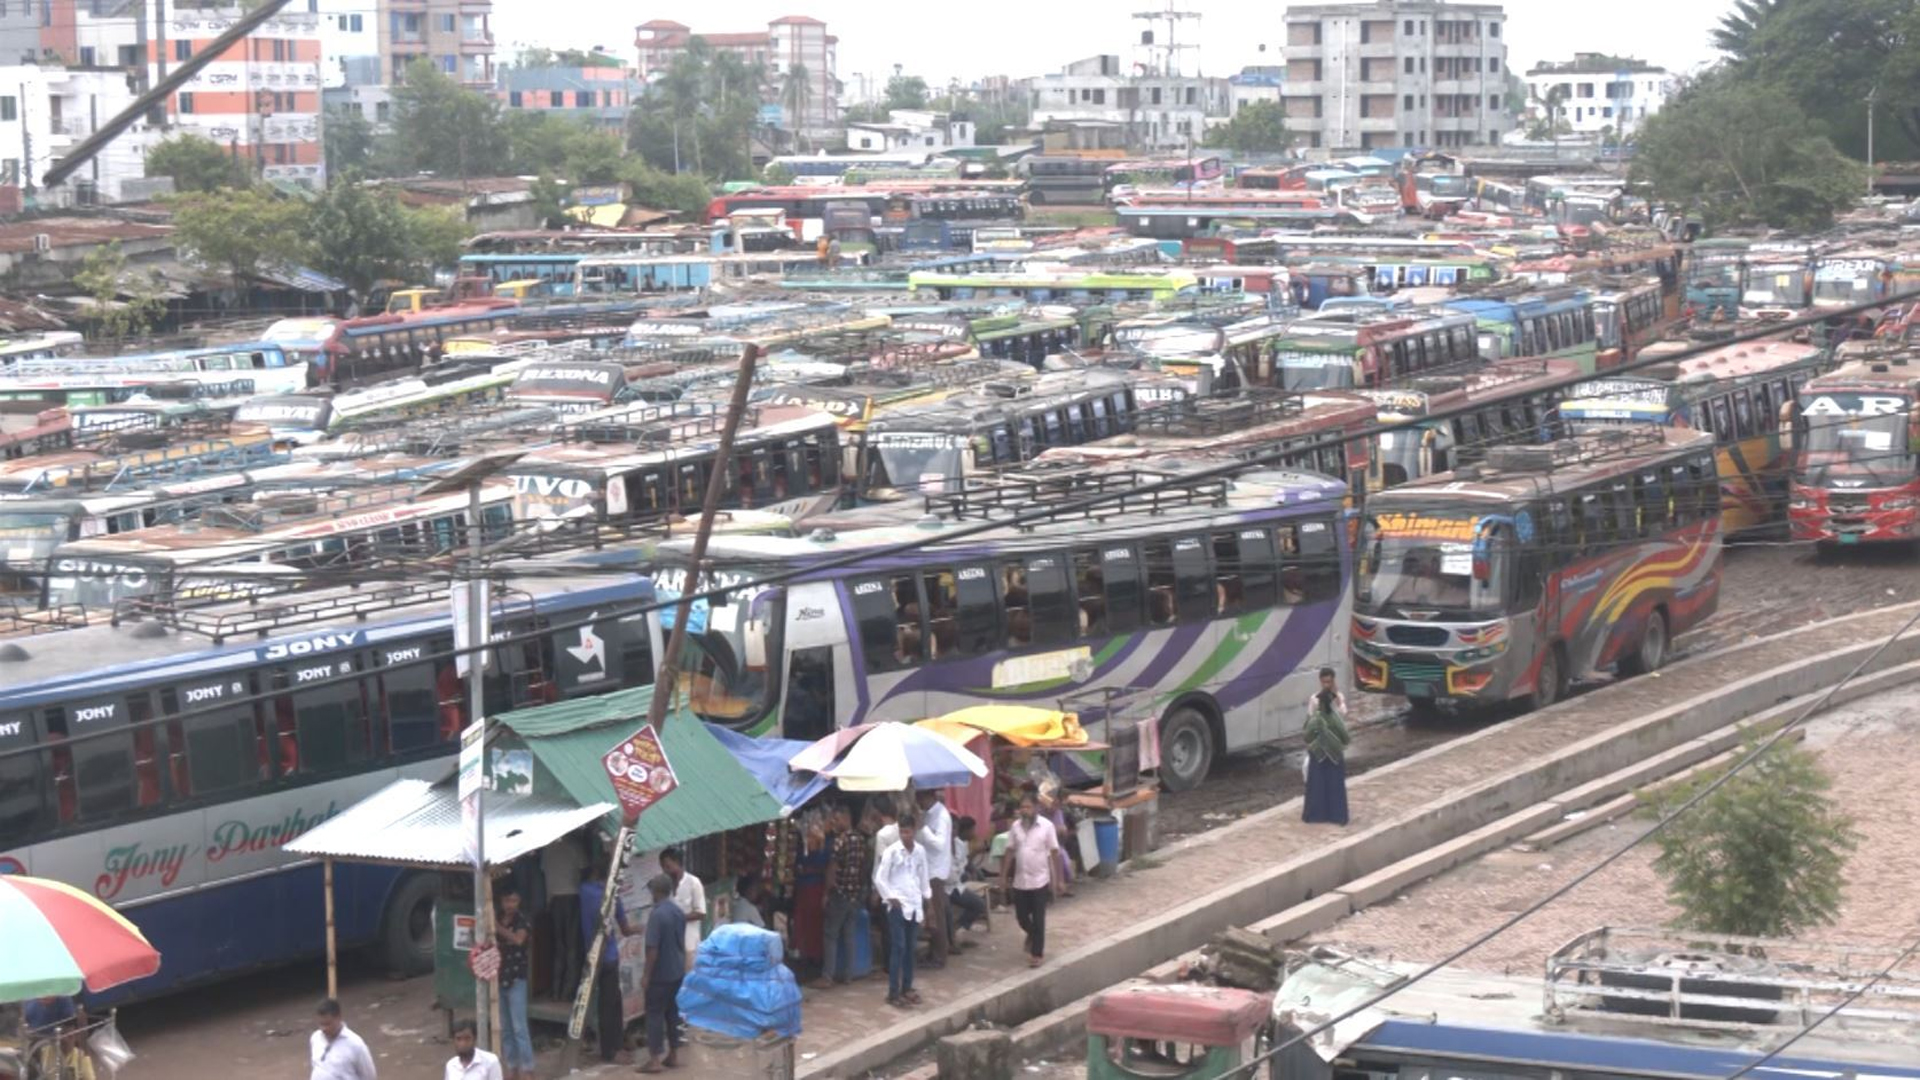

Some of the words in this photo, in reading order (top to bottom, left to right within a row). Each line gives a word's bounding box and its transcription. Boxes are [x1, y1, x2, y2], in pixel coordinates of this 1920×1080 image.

[507, 475, 592, 498] UVO
[265, 630, 357, 660] JONY
[297, 665, 332, 682] JONY
[186, 685, 223, 702] JONY
[75, 704, 115, 723] JONY
[95, 842, 187, 899] Jony
